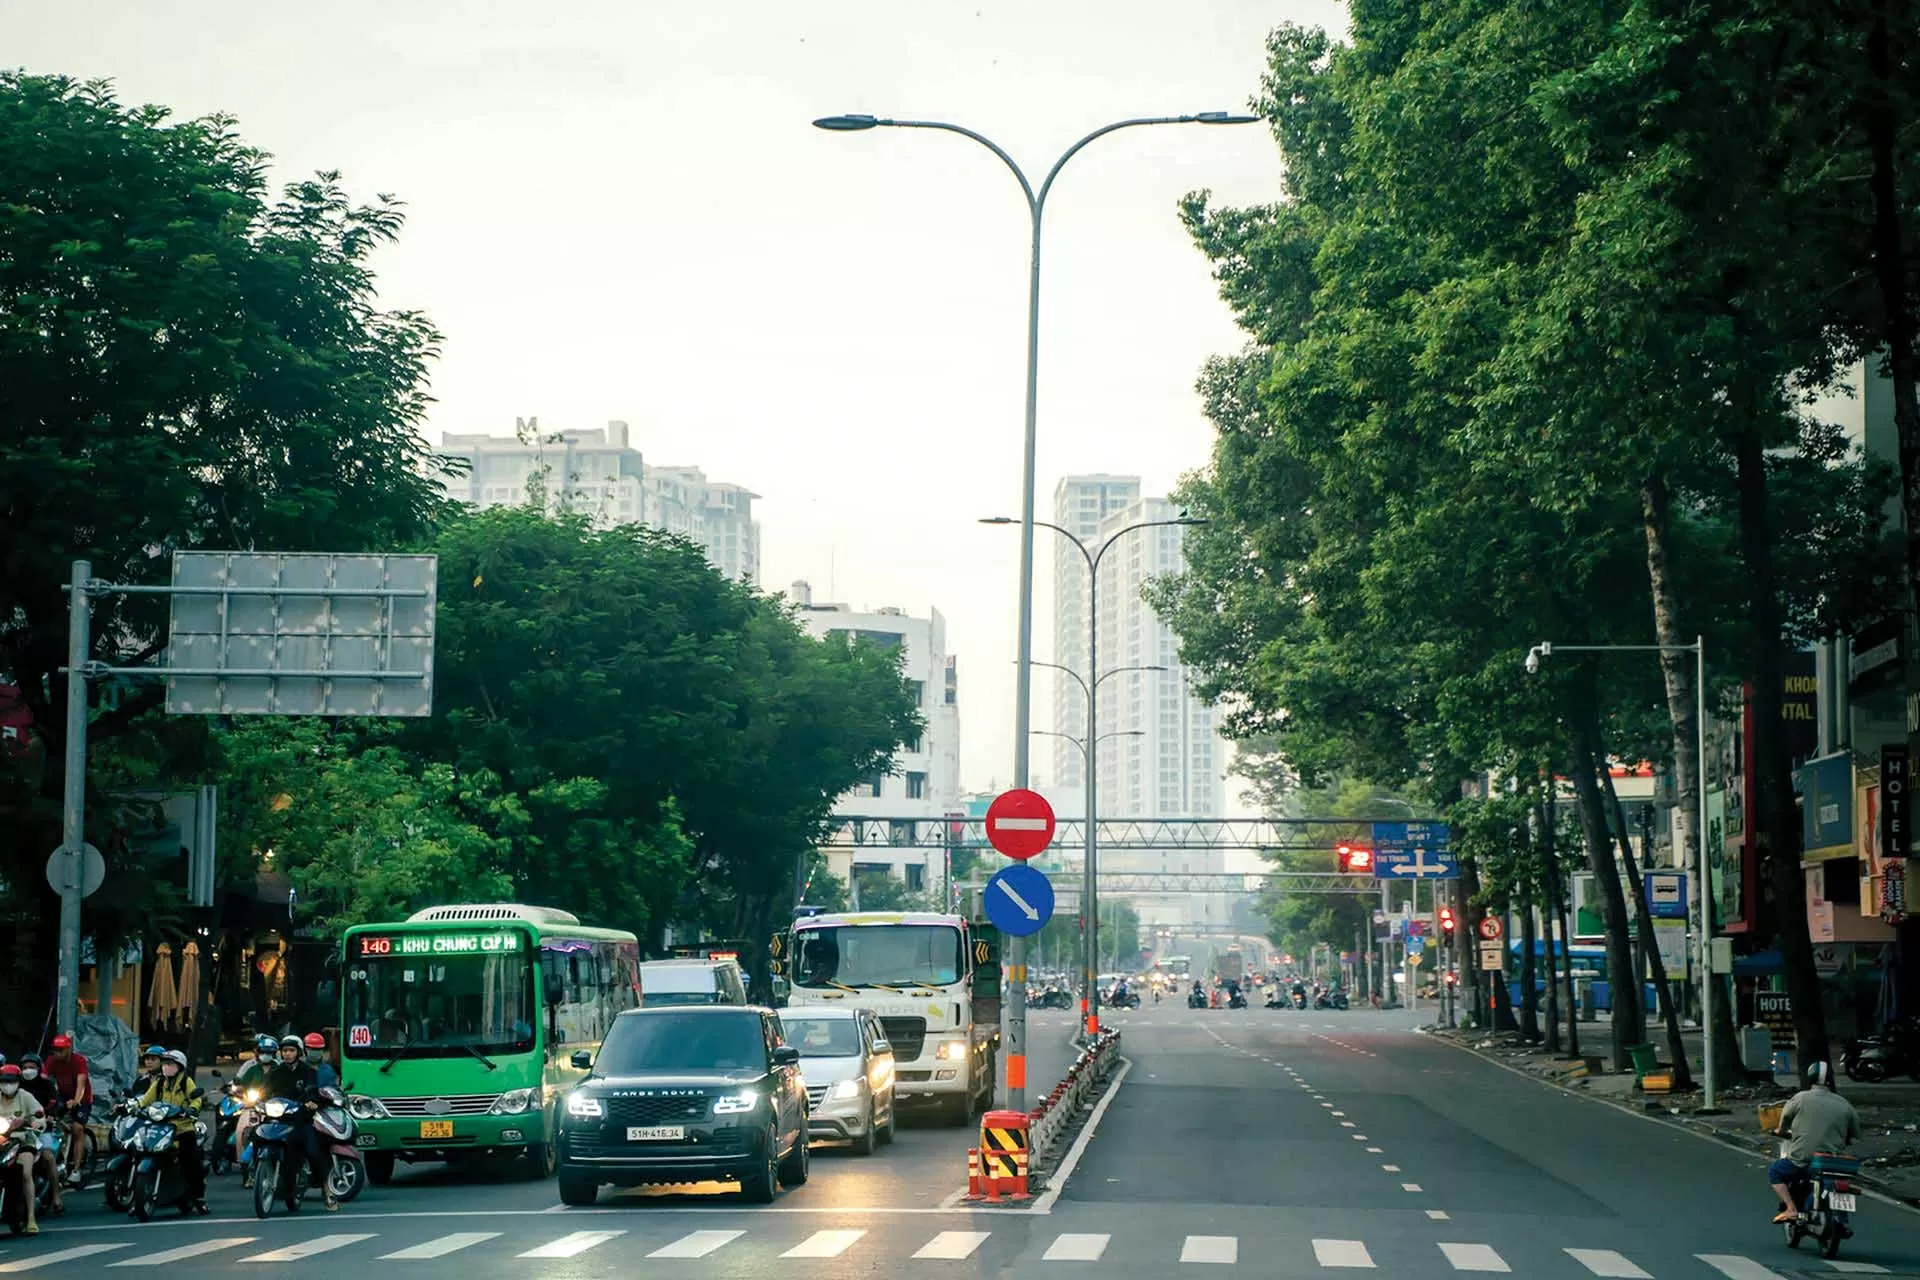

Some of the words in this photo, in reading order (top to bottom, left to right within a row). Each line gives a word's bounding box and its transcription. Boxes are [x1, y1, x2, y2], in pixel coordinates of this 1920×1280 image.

[1888, 761, 1902, 852] HOTEL
[361, 938, 391, 954] 140
[403, 937, 430, 953] KHU
[433, 935, 477, 951] CHUNG
[1760, 998, 1791, 1011] HOTE
[351, 1028, 369, 1044] 140
